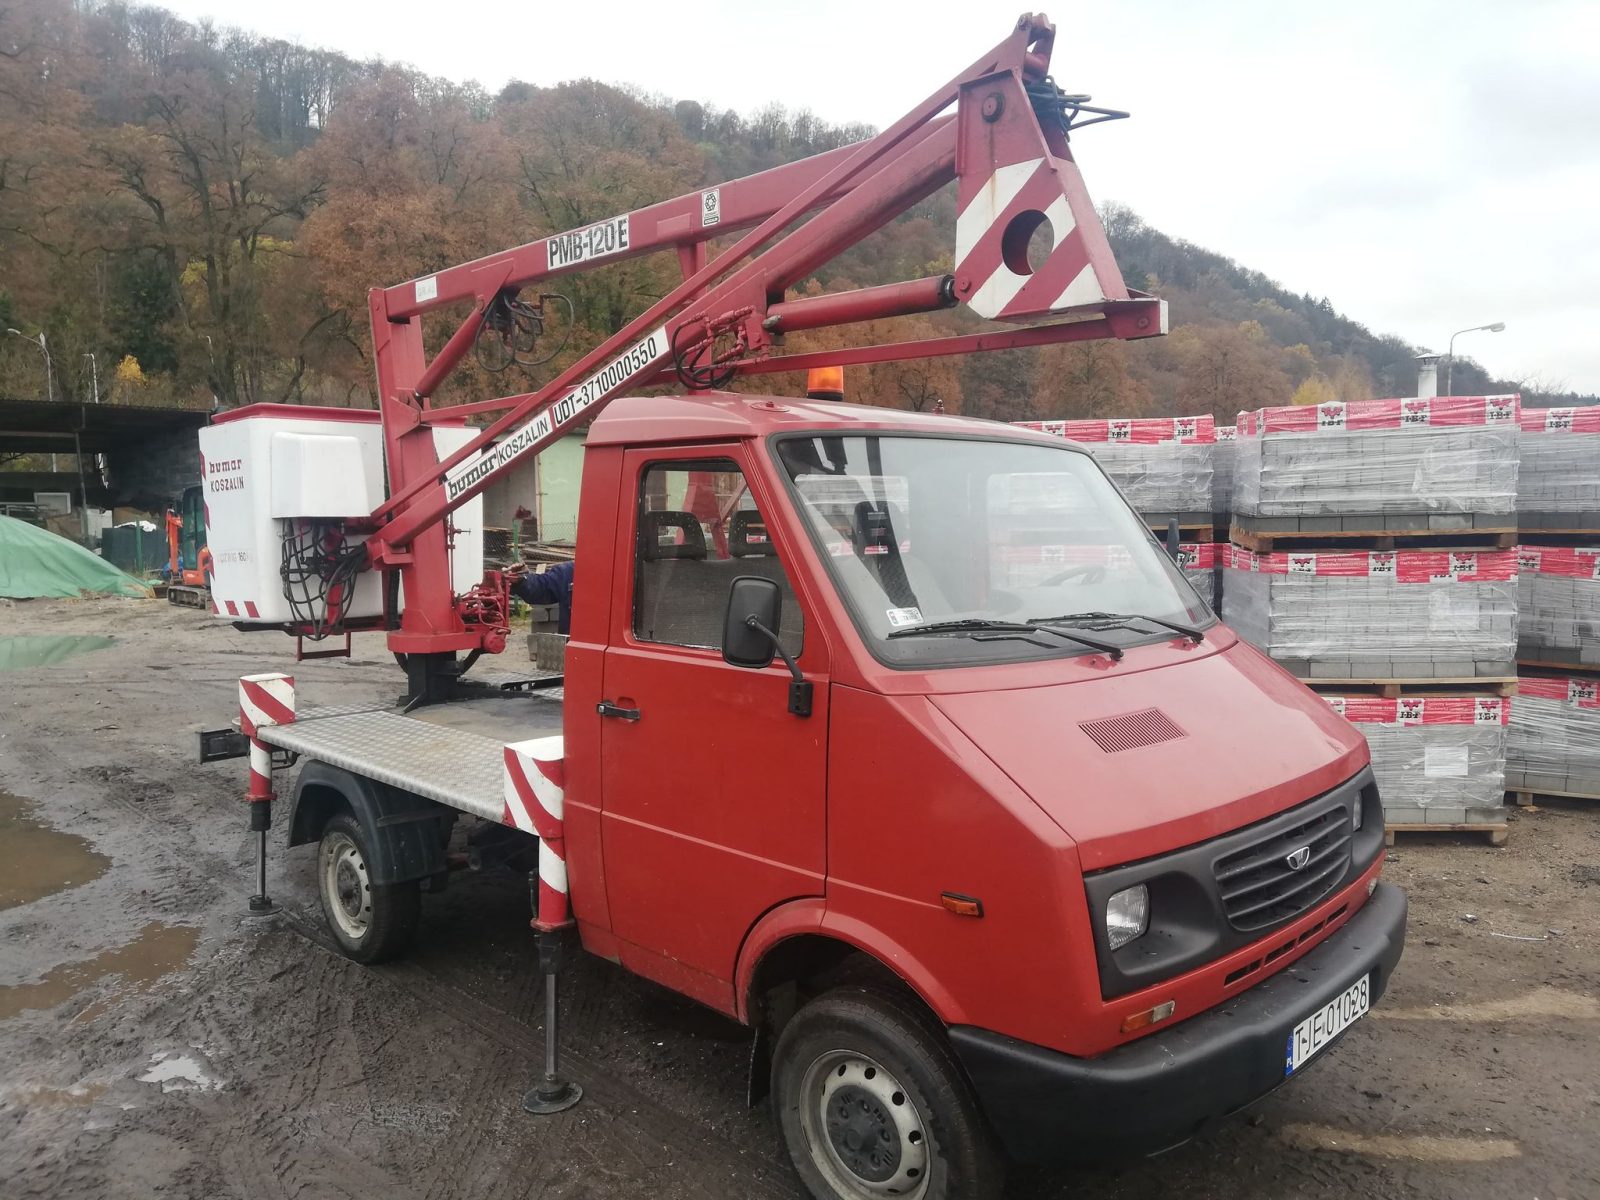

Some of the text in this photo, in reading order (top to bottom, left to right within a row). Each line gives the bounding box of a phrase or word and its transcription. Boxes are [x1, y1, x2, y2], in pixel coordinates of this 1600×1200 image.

[549, 222, 615, 267] PMB-120
[553, 337, 657, 425] UDT-3710000550
[209, 459, 242, 474] bumar
[210, 476, 245, 492] KOSZALIN
[447, 417, 549, 500] bumar KOSZALIN
[1295, 980, 1367, 1062] TJE 01028
